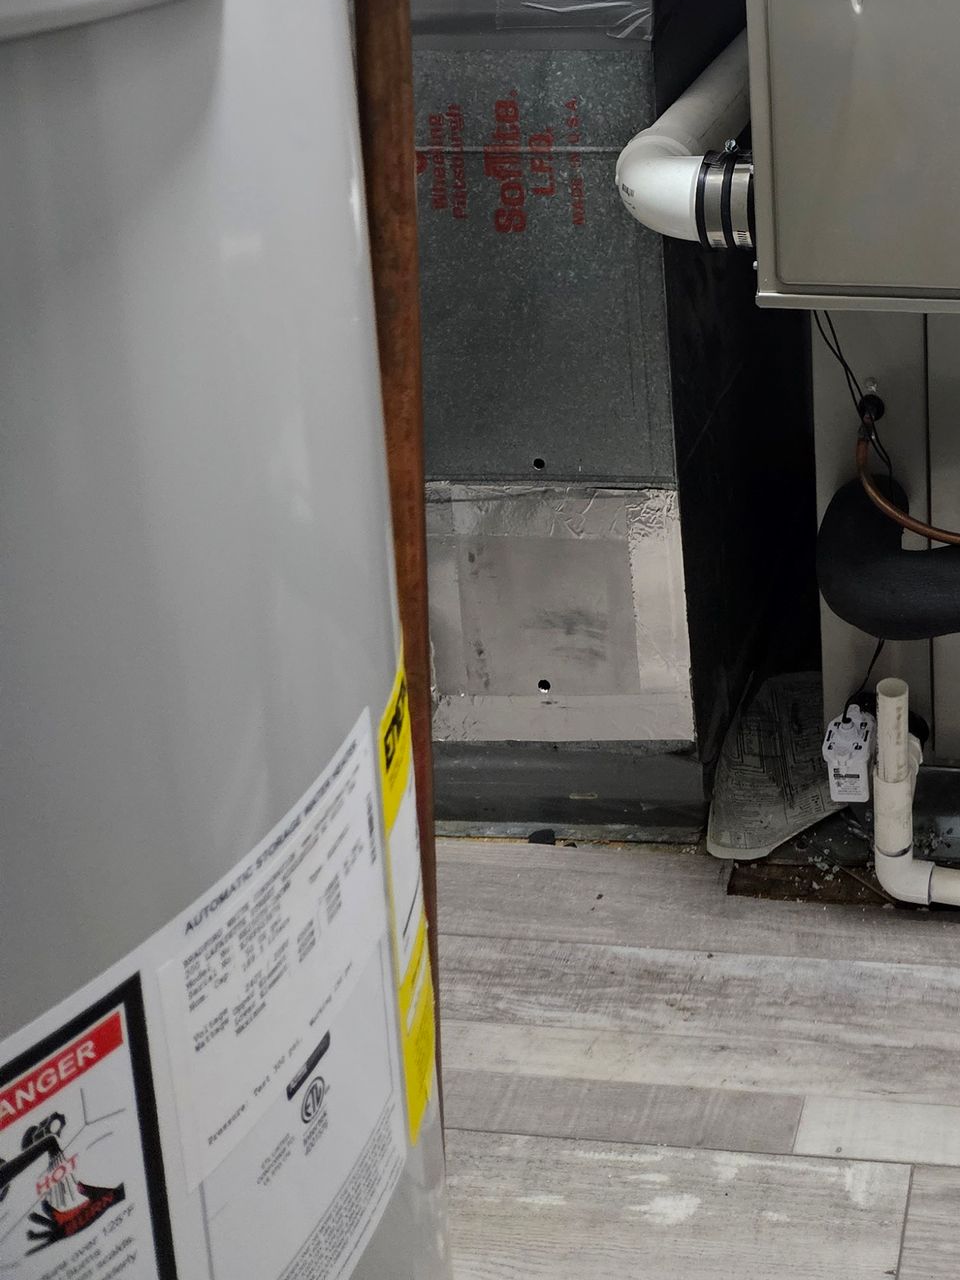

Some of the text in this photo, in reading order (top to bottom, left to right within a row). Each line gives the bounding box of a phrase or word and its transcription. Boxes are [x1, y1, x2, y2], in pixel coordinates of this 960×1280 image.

[571, 177, 585, 225] MADE
[185, 864, 253, 935] AUTOMATIC
[36, 1153, 78, 1195] HOT
[72, 1237, 98, 1261] over
